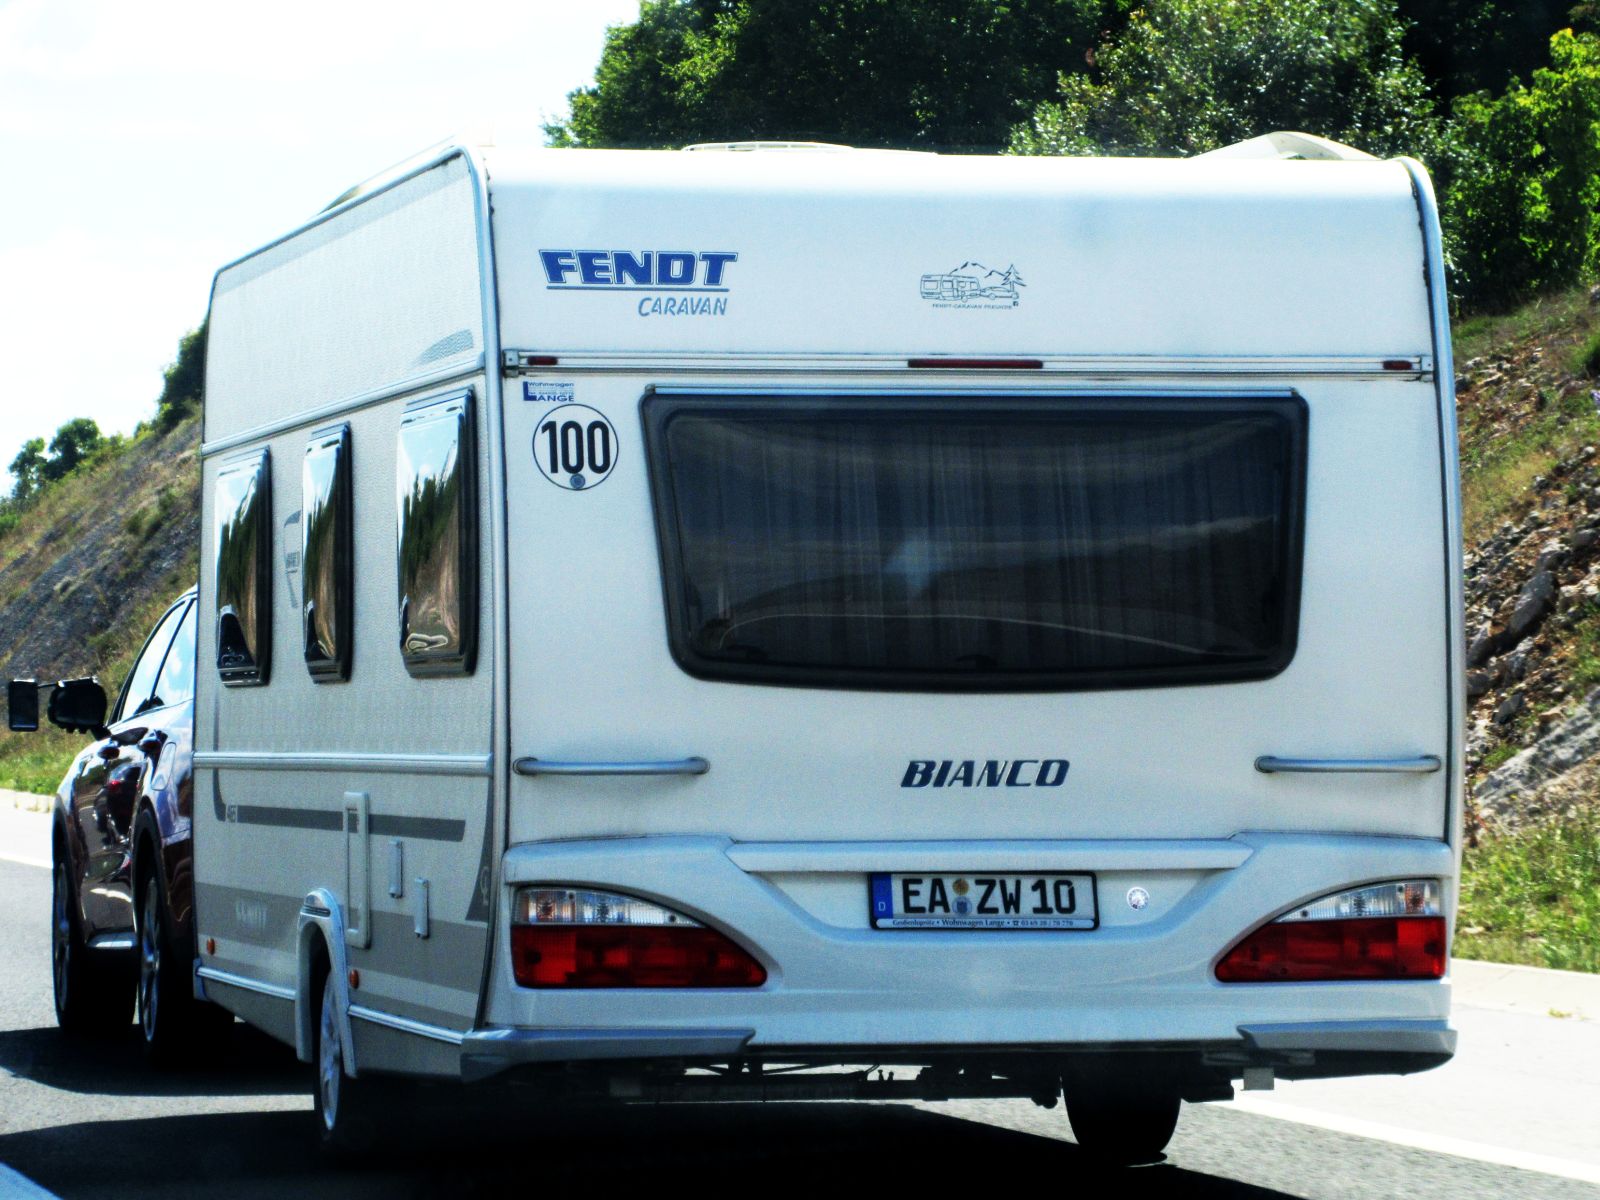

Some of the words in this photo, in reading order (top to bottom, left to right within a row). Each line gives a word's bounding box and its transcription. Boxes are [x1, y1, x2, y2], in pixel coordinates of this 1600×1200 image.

[539, 250, 738, 285] FENDT
[638, 297, 728, 316] CARAVAN
[541, 420, 611, 474] 100
[901, 759, 1070, 787] BIANCO
[878, 902, 886, 912] D
[902, 878, 950, 913] EA
[975, 879, 1021, 914] ZW
[1031, 879, 1076, 914] 10
